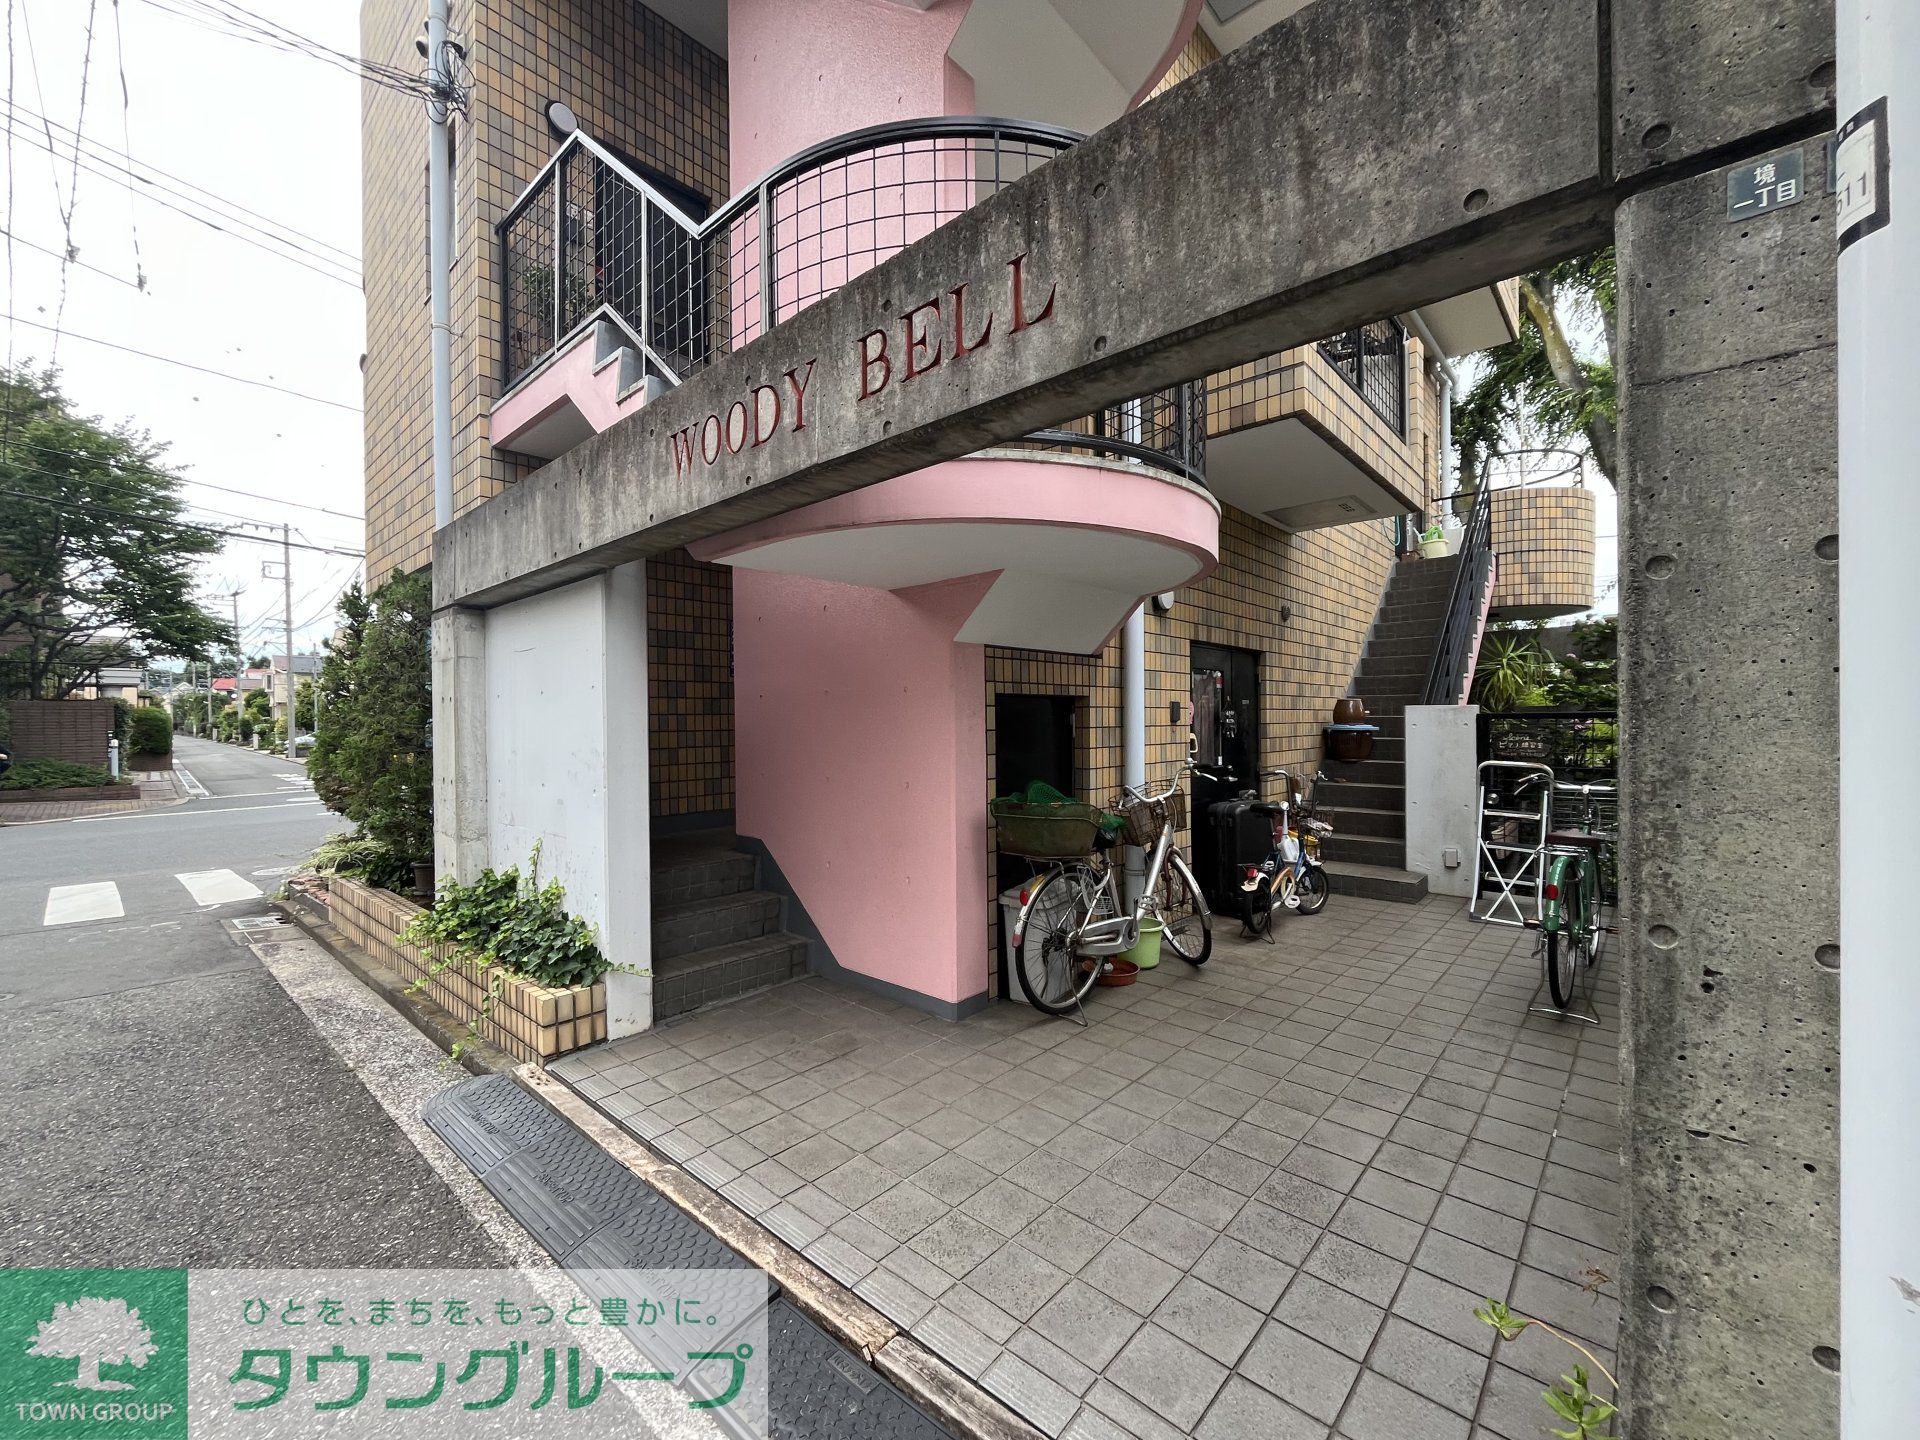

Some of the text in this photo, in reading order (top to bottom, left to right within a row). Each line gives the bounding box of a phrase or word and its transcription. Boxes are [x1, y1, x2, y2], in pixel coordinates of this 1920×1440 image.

[1753, 163, 1776, 186] 境
[1733, 178, 1796, 209] 一丁目
[670, 251, 1057, 484] WOODY BELL
